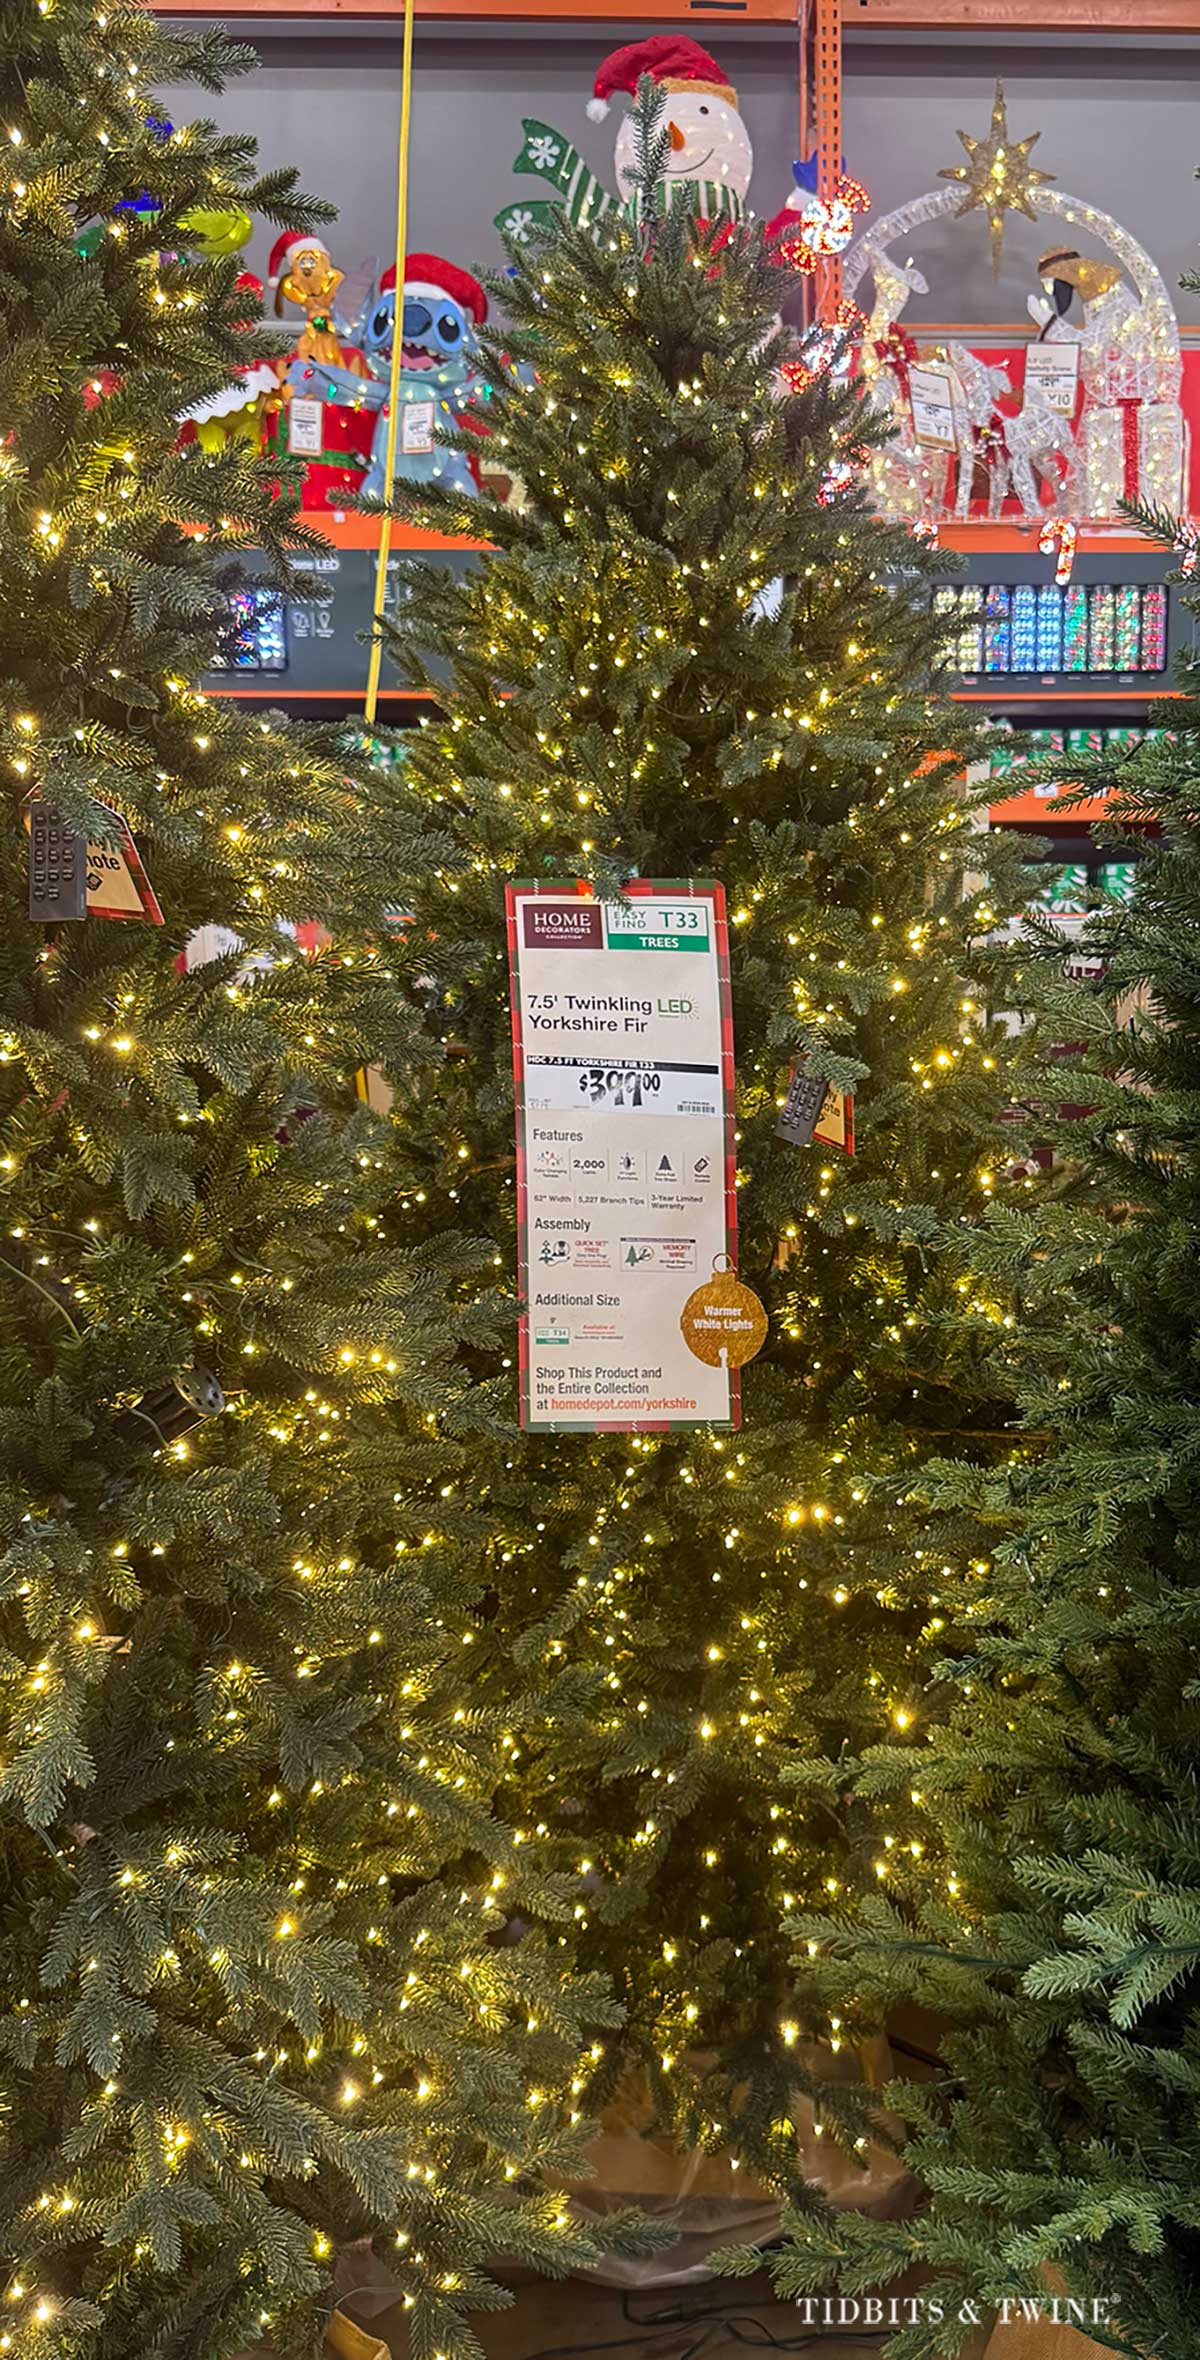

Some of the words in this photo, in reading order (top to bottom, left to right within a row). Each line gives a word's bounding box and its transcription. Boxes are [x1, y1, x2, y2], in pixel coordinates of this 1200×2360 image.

[534, 912, 592, 927] HOME
[614, 910, 647, 920] EASY
[658, 911, 699, 929] T33
[534, 926, 592, 934] DECORATORS
[614, 919, 647, 929] FIND
[639, 936, 680, 948] TREES
[527, 995, 558, 1009] 7.5'
[564, 995, 652, 1015] Twinkling
[657, 998, 693, 1014] LED
[528, 1014, 618, 1032] Yorkshire
[624, 1017, 648, 1033] Fir
[532, 1128, 584, 1142] Features
[573, 1159, 606, 1170] 2,000
[600, 1196, 627, 1204] Branch
[629, 1196, 645, 1205] Tips
[651, 1194, 675, 1202] 3-Year
[676, 1195, 704, 1203] Limited
[651, 1202, 684, 1211] Warranty
[534, 1217, 591, 1232] Assembly
[535, 1293, 593, 1306] Additional
[596, 1294, 621, 1306] Size
[703, 1305, 743, 1316] Warmer
[693, 1318, 721, 1329] White
[723, 1318, 754, 1331] Lights
[536, 1366, 565, 1380] Shop
[568, 1366, 592, 1379] This
[595, 1367, 638, 1379] Product
[641, 1367, 662, 1379] and
[536, 1382, 555, 1394] the
[558, 1382, 591, 1394] Entire
[594, 1382, 649, 1394] Collection
[536, 1399, 548, 1410] at
[551, 1397, 697, 1412] homedepot.com/yorkshire
